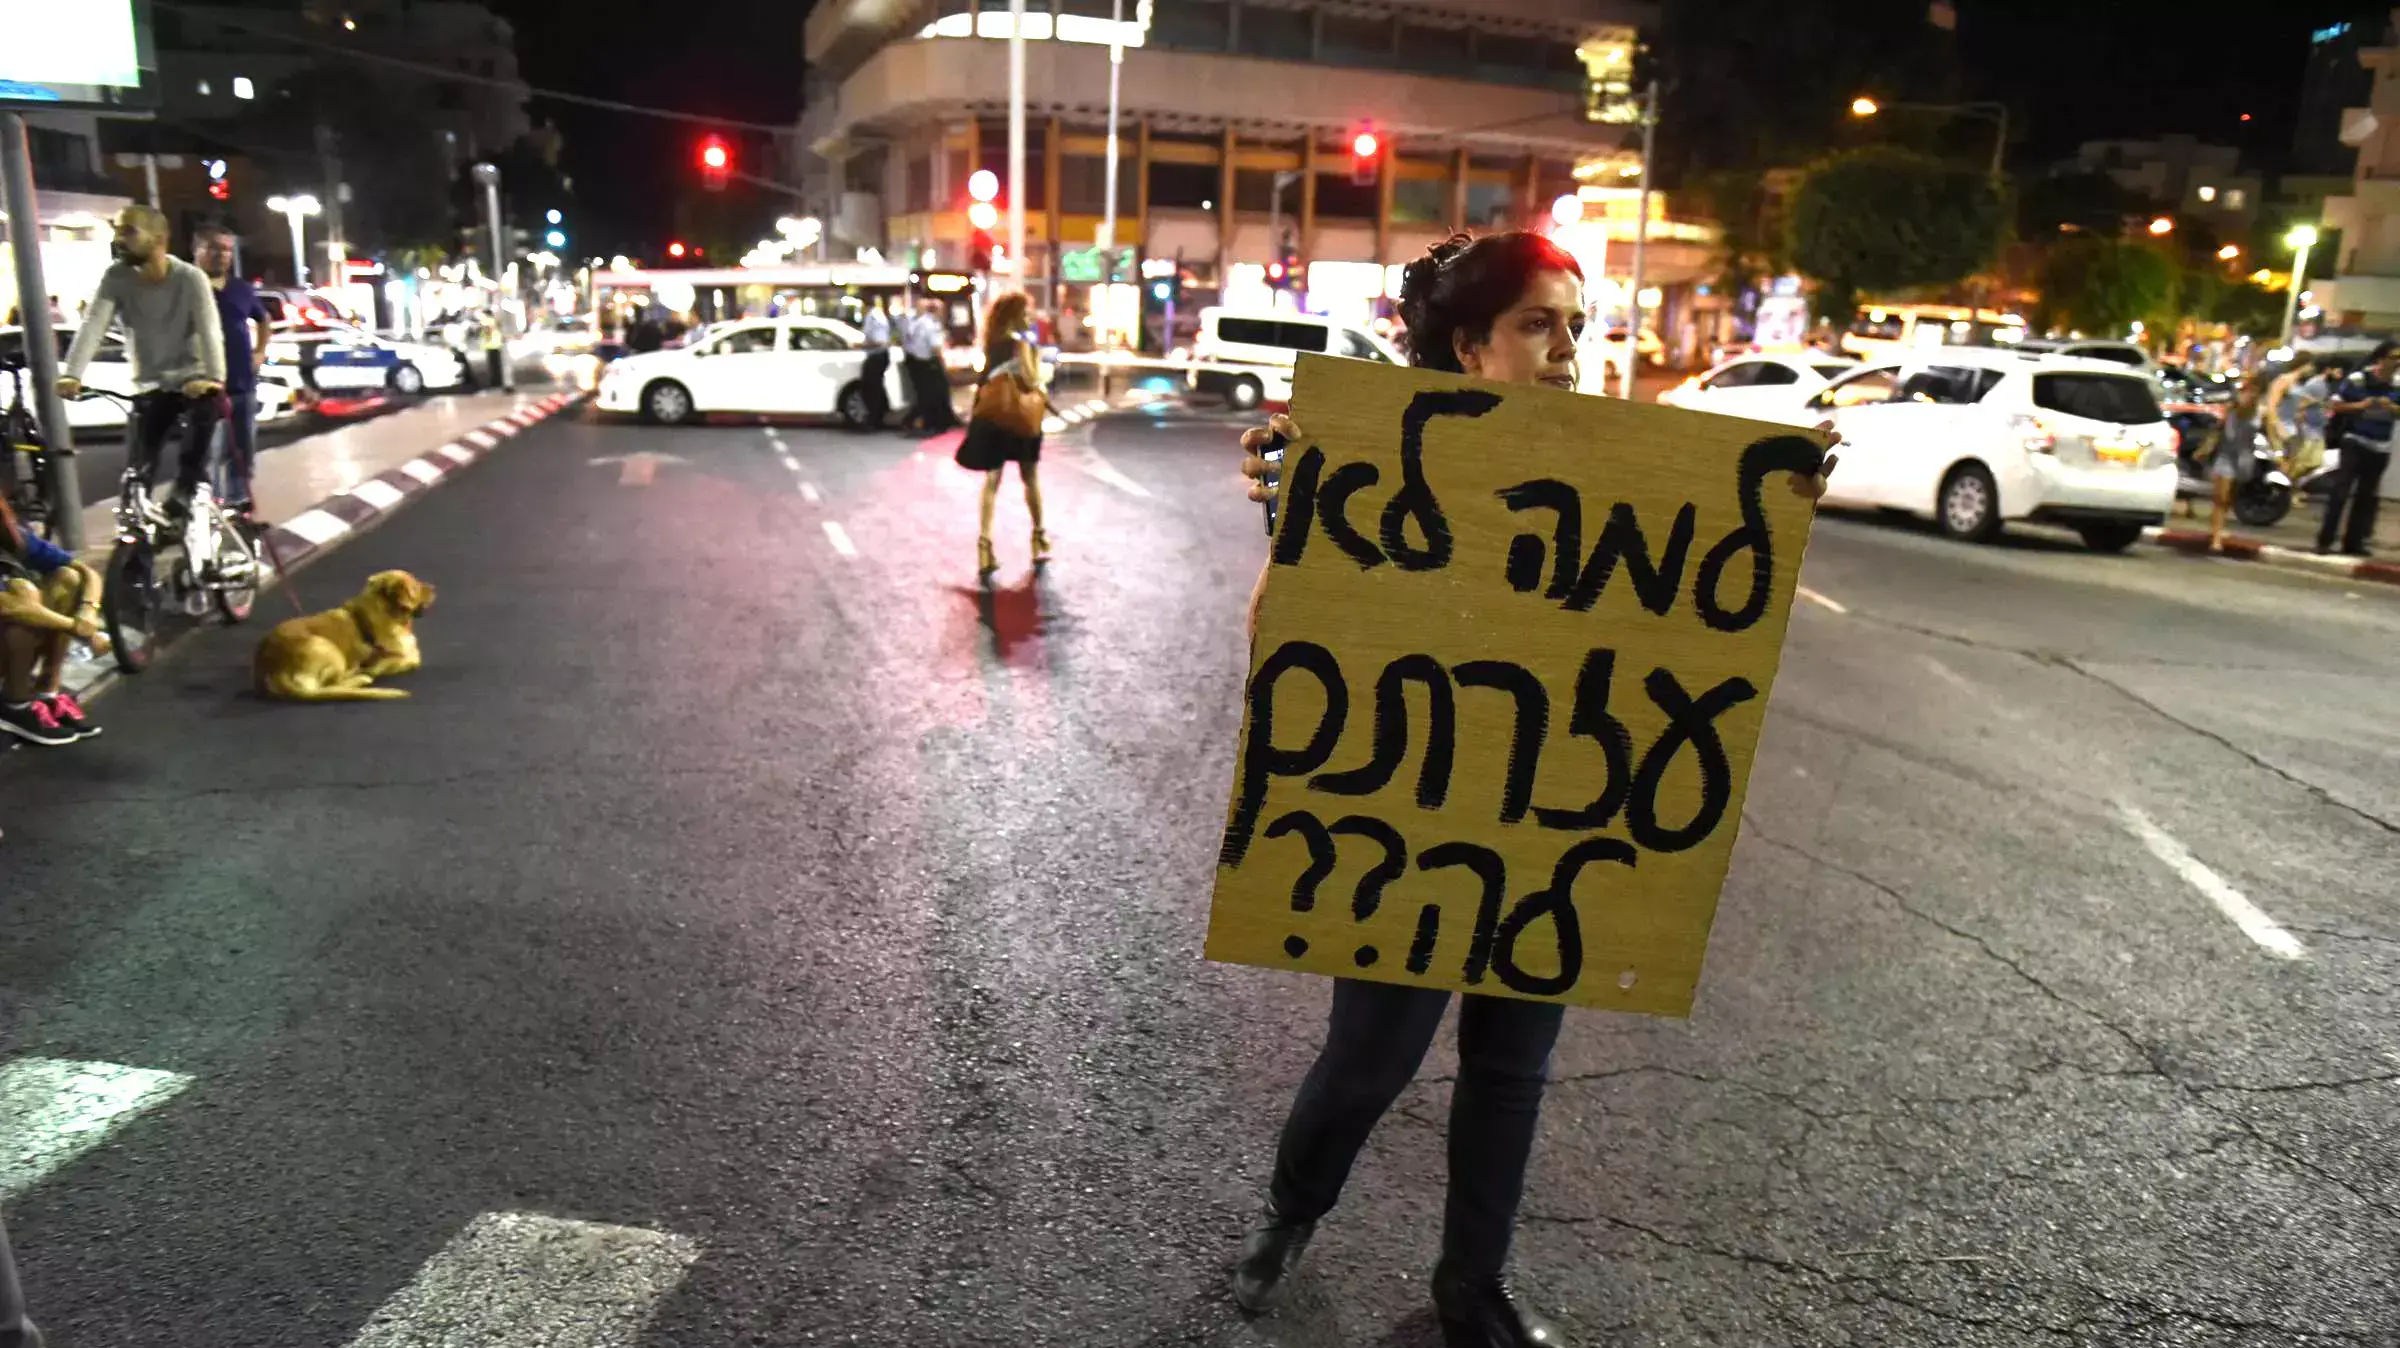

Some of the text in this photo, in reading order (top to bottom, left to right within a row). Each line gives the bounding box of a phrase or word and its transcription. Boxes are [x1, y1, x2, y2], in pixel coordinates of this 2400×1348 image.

[1272, 389, 1825, 632] למה לא
[1220, 641, 1759, 870] עזרתם
